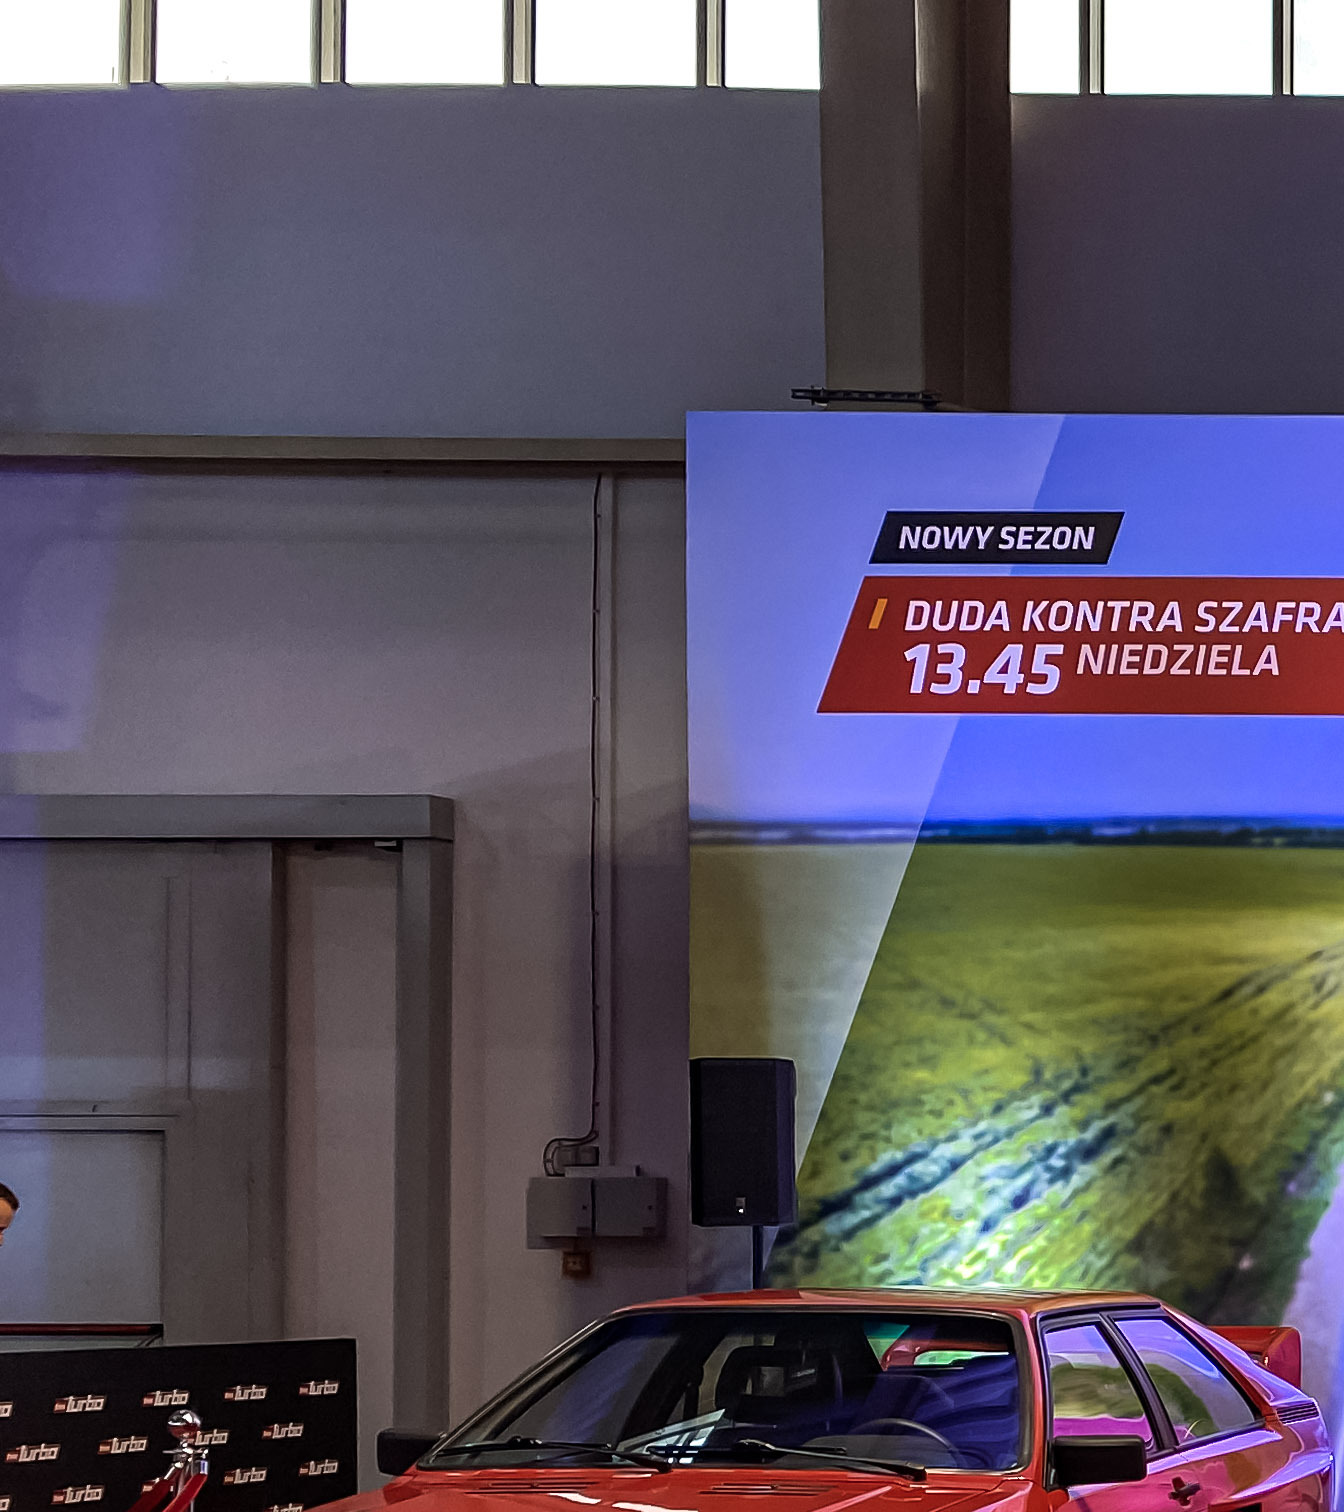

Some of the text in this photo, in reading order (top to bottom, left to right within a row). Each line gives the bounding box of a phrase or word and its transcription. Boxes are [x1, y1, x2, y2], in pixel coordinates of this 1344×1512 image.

[898, 524, 1095, 551] NOWY SEZON
[905, 600, 1011, 633] DUDA
[1021, 600, 1182, 633] KONTRA
[903, 643, 1281, 696] 13.45 NIEDZIELA
